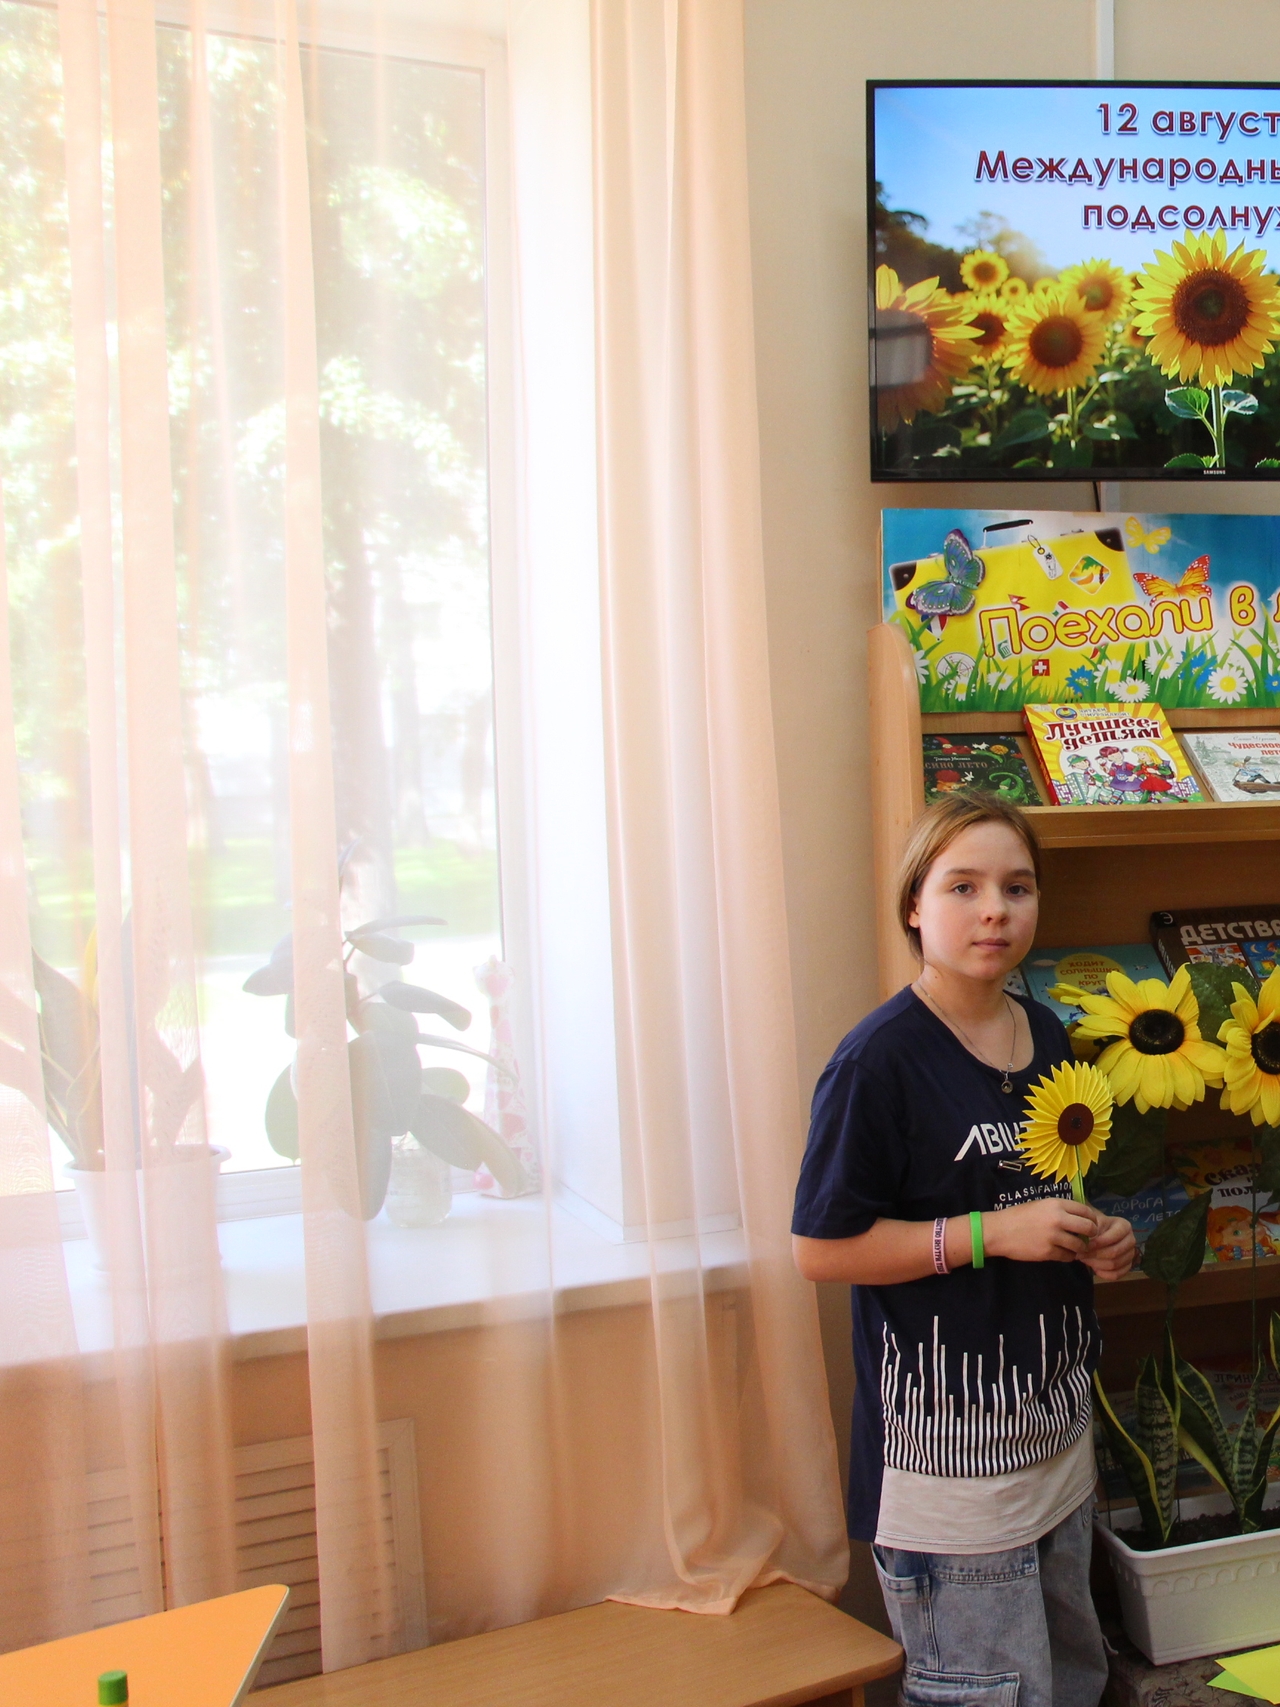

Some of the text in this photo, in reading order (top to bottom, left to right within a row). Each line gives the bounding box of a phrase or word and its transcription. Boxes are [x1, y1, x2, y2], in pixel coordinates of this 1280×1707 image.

[1099, 102, 1138, 135] 12
[978, 593, 1214, 659] Поехали
[1230, 584, 1257, 623] в
[1045, 718, 1159, 741] Лучшее-
[1063, 728, 1161, 750] детям
[1060, 967, 1120, 975] СОЛНЫШКО
[1217, 1186, 1260, 1198] пол
[1111, 1197, 1163, 1214] ДОРОГА
